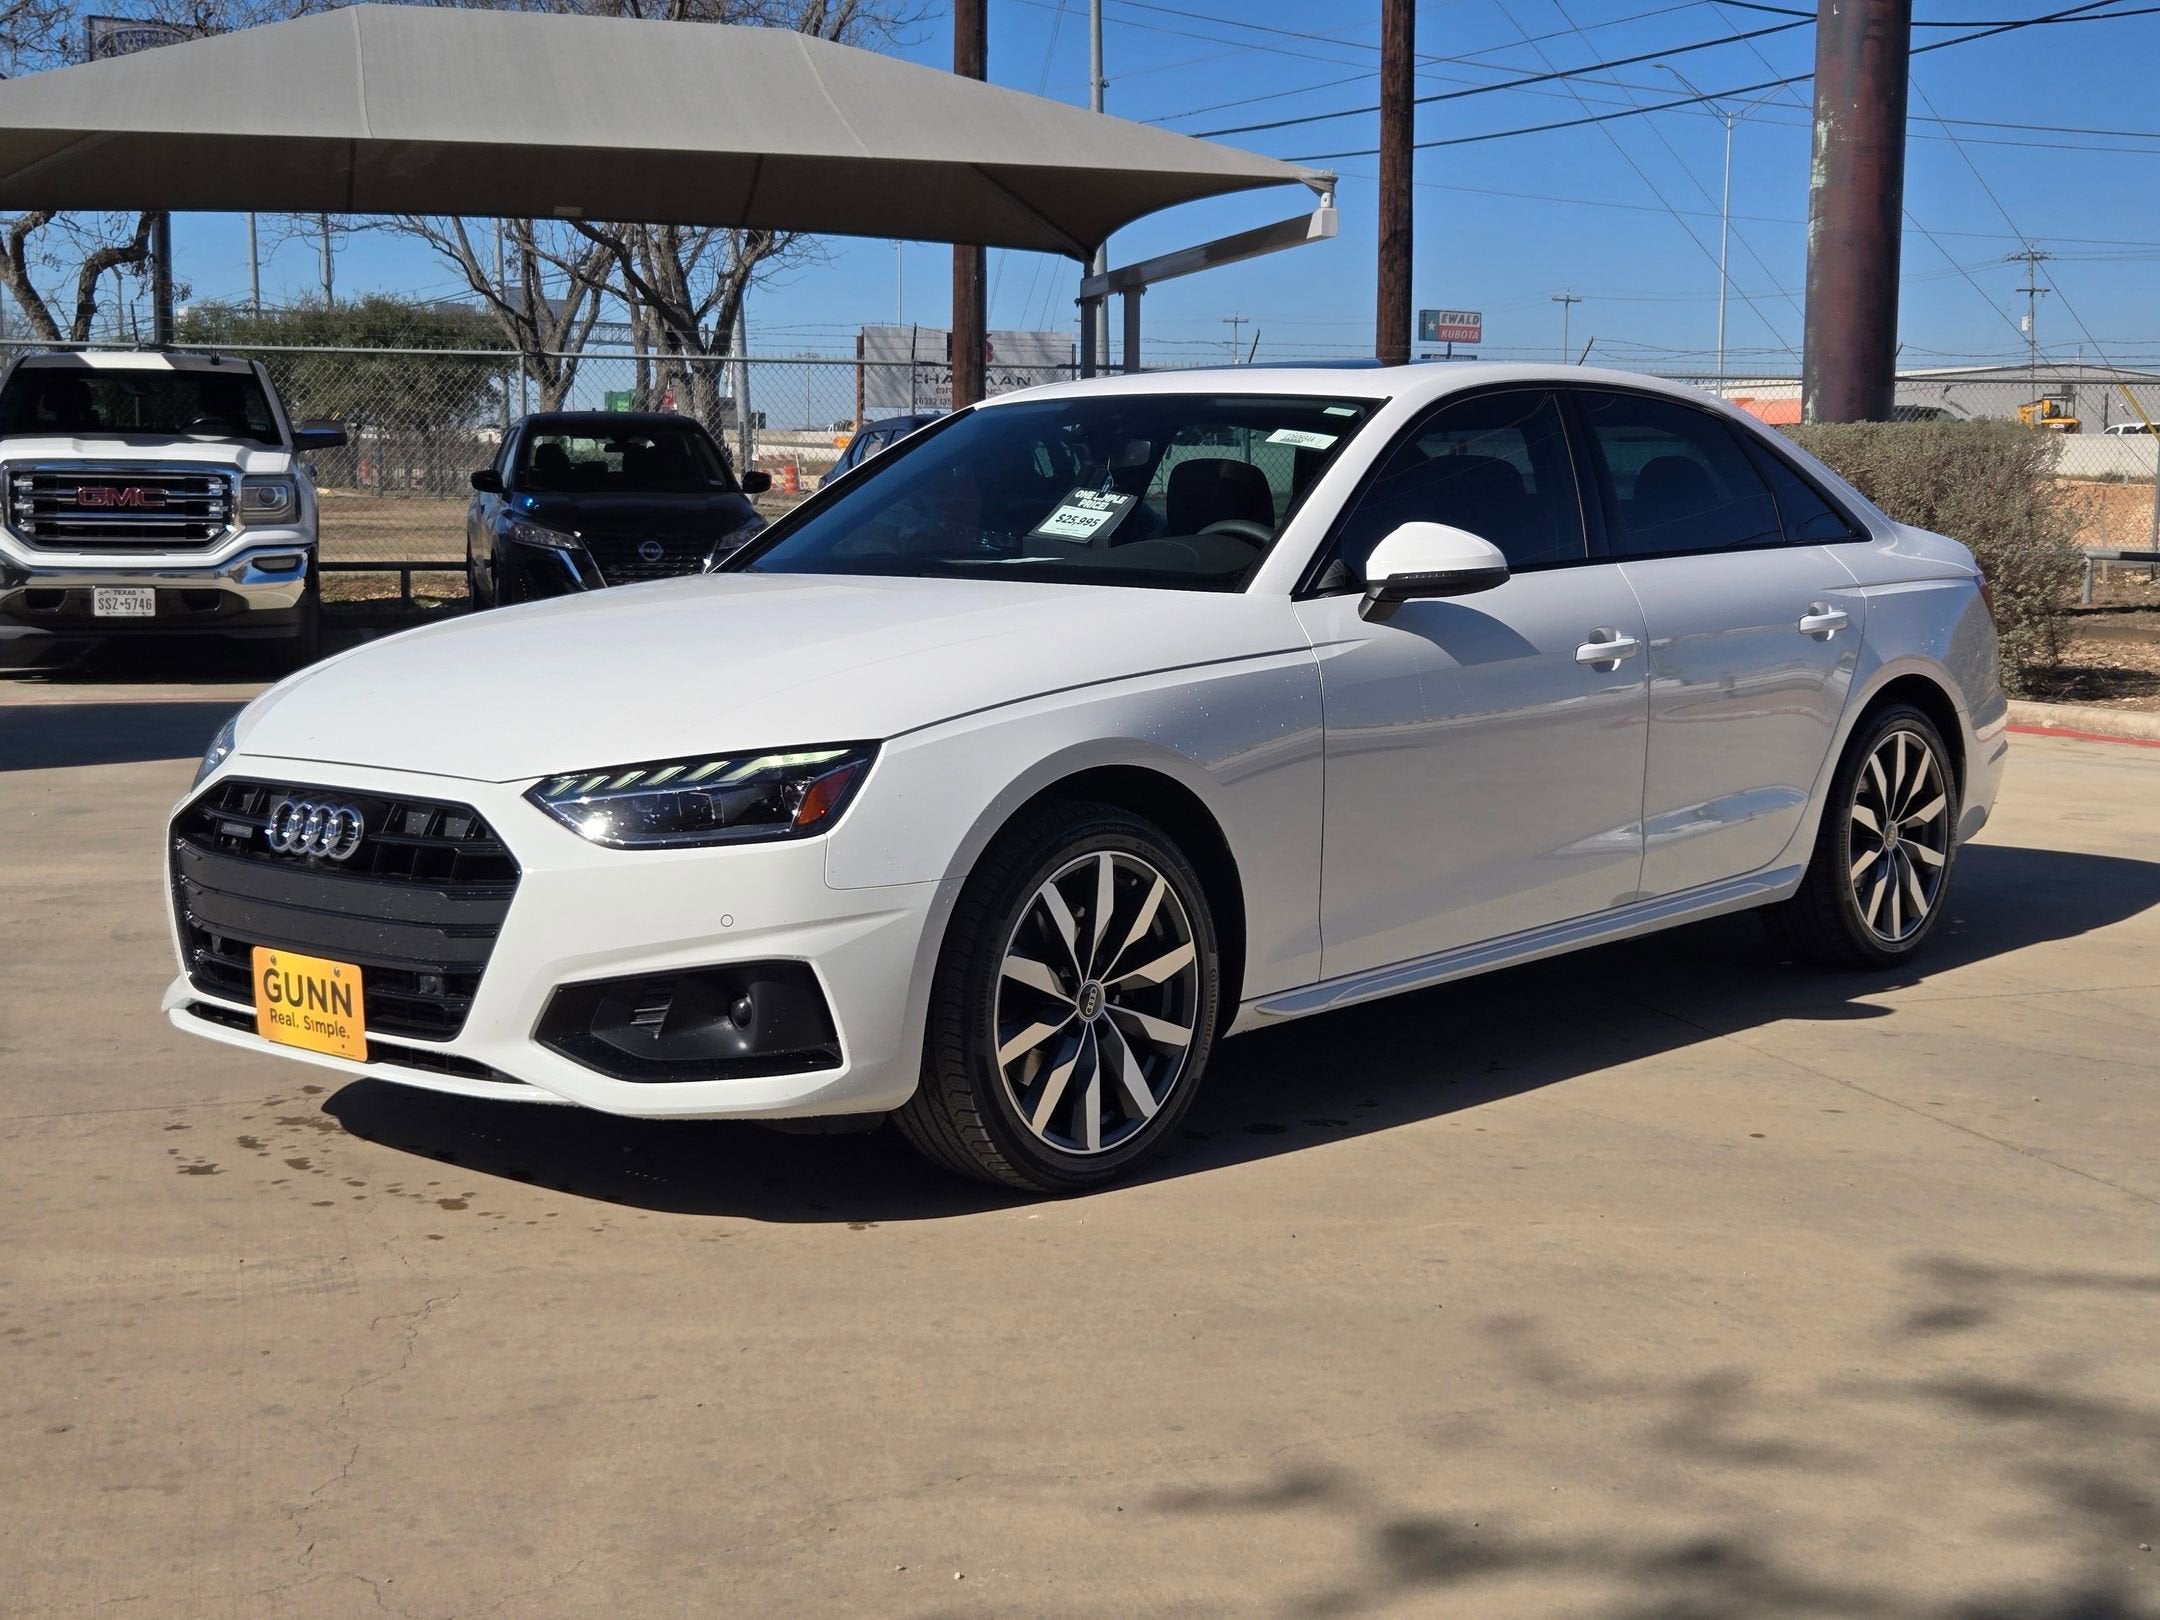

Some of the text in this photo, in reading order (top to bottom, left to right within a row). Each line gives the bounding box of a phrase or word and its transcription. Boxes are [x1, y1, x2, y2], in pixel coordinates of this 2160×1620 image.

[1441, 313, 1479, 325] EWALD
[1441, 329, 1479, 340] KUBOTA
[78, 487, 166, 507] GMC
[1075, 490, 1097, 500] ONE
[1055, 513, 1101, 527] $25,995
[263, 968, 353, 1018] GUNN
[270, 1008, 299, 1028] Real.
